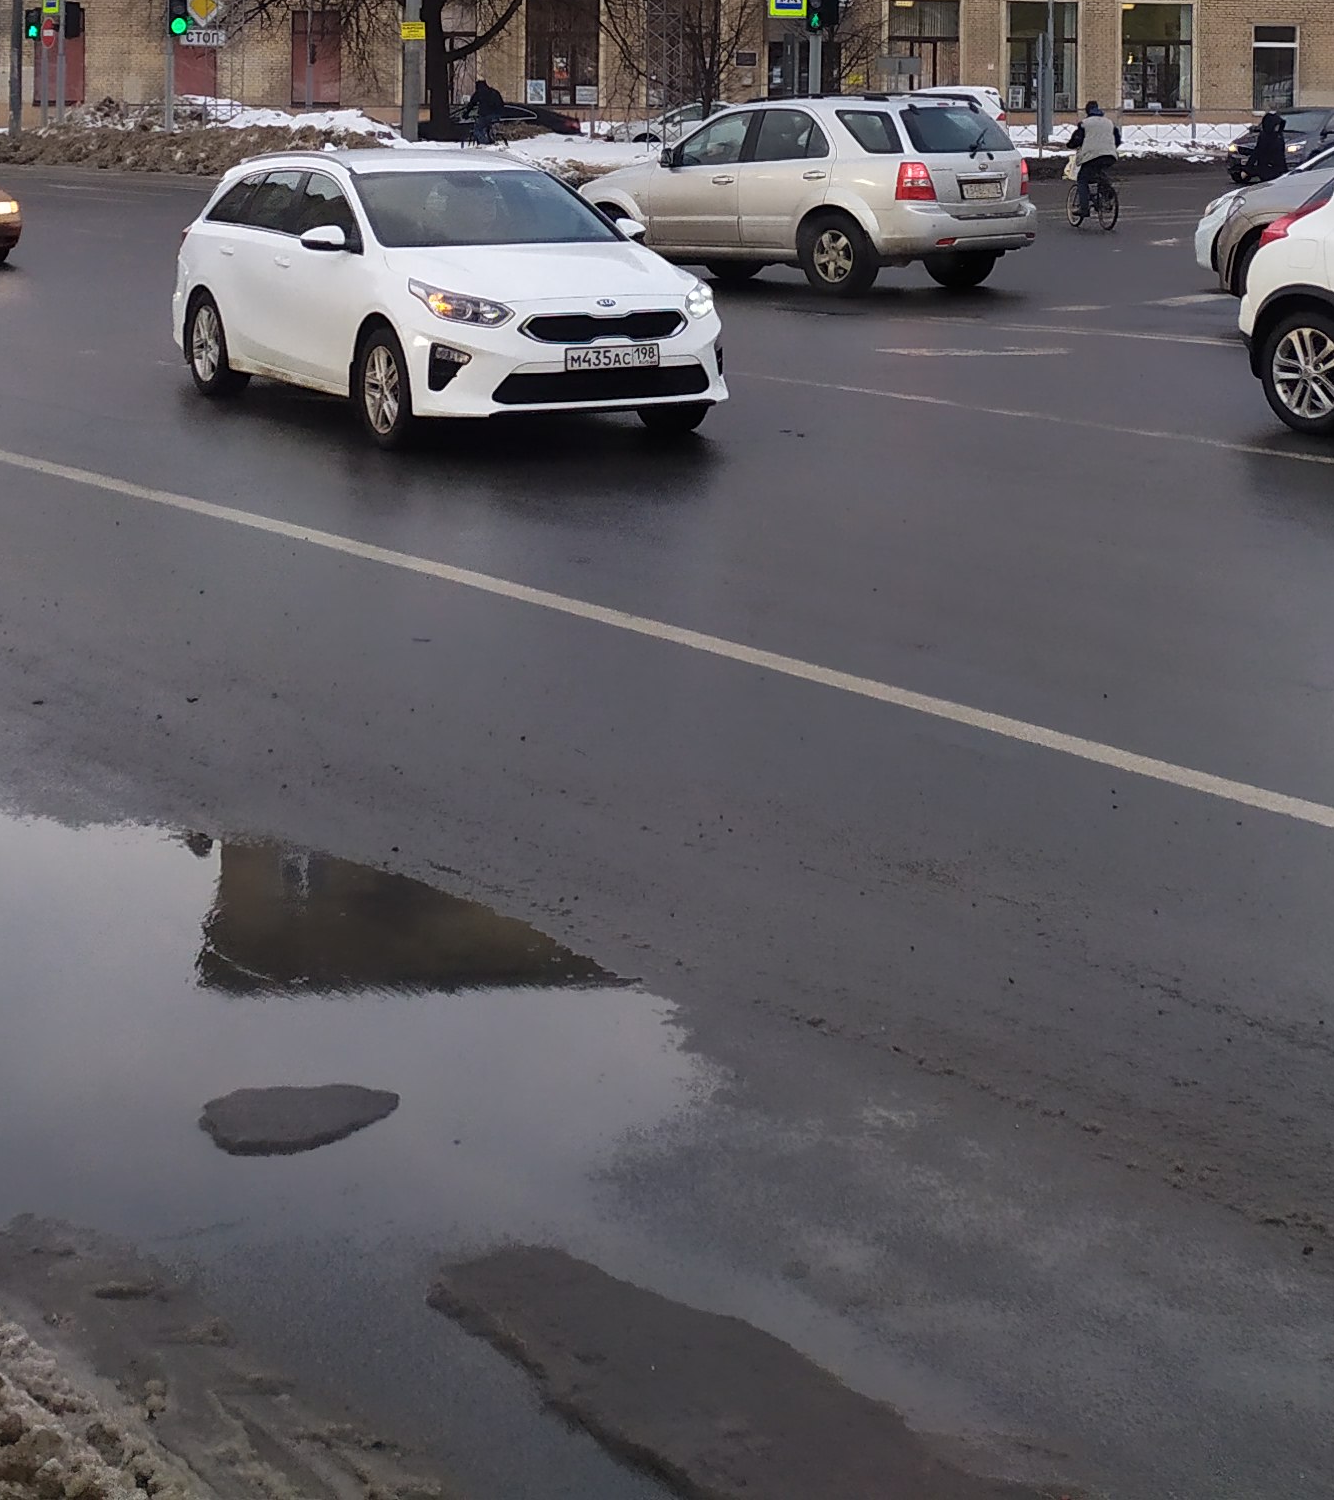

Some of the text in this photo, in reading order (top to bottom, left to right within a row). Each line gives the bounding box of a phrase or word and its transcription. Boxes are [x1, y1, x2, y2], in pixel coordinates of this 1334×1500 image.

[186, 31, 220, 43] СТОП
[570, 346, 656, 368] М435АС 198
